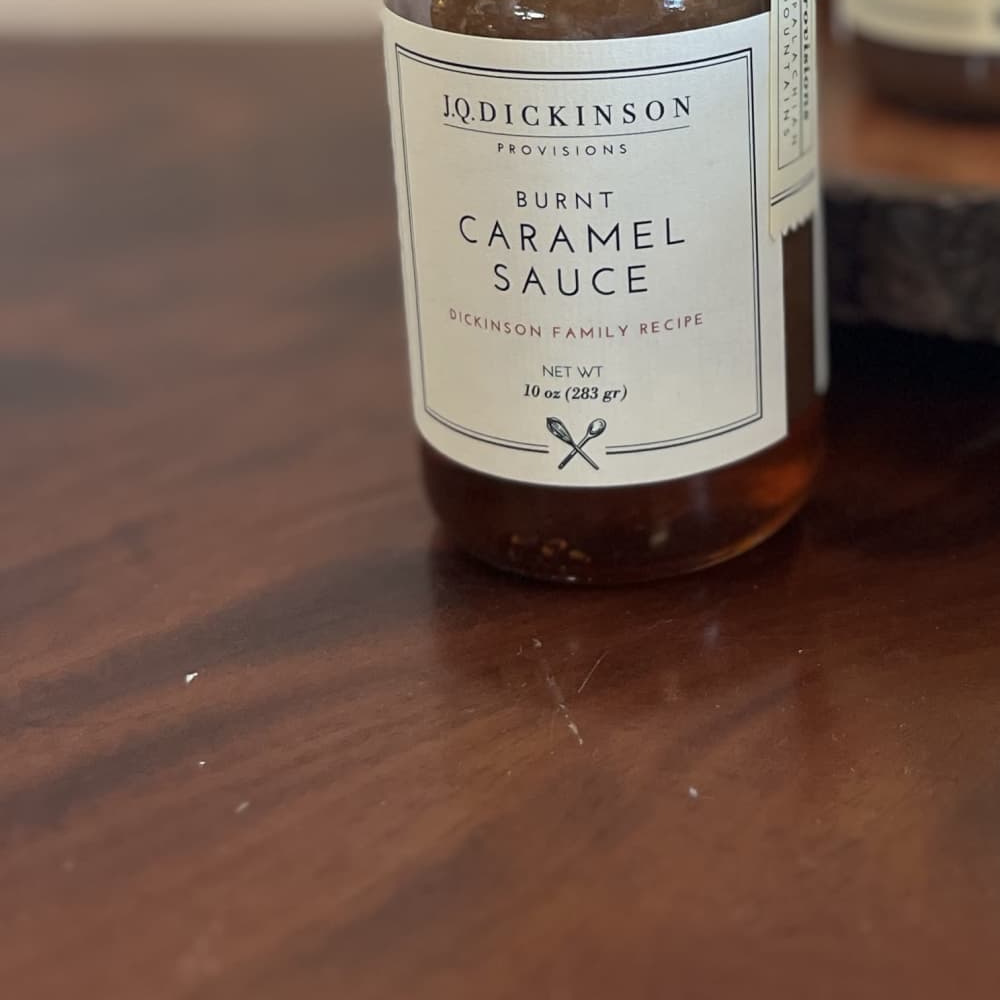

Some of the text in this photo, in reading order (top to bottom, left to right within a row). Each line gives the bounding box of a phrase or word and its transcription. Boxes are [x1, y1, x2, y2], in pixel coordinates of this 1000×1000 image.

[497, 142, 629, 157] PROVISIONS
[515, 190, 615, 210] BURNT
[459, 215, 685, 253] CARAMEL
[493, 264, 649, 297] SAUCE
[448, 308, 705, 339] DICKINSON FAMILY RECIPE
[542, 365, 604, 379] NET WT
[523, 383, 628, 403] 10 oz (283 gr)
